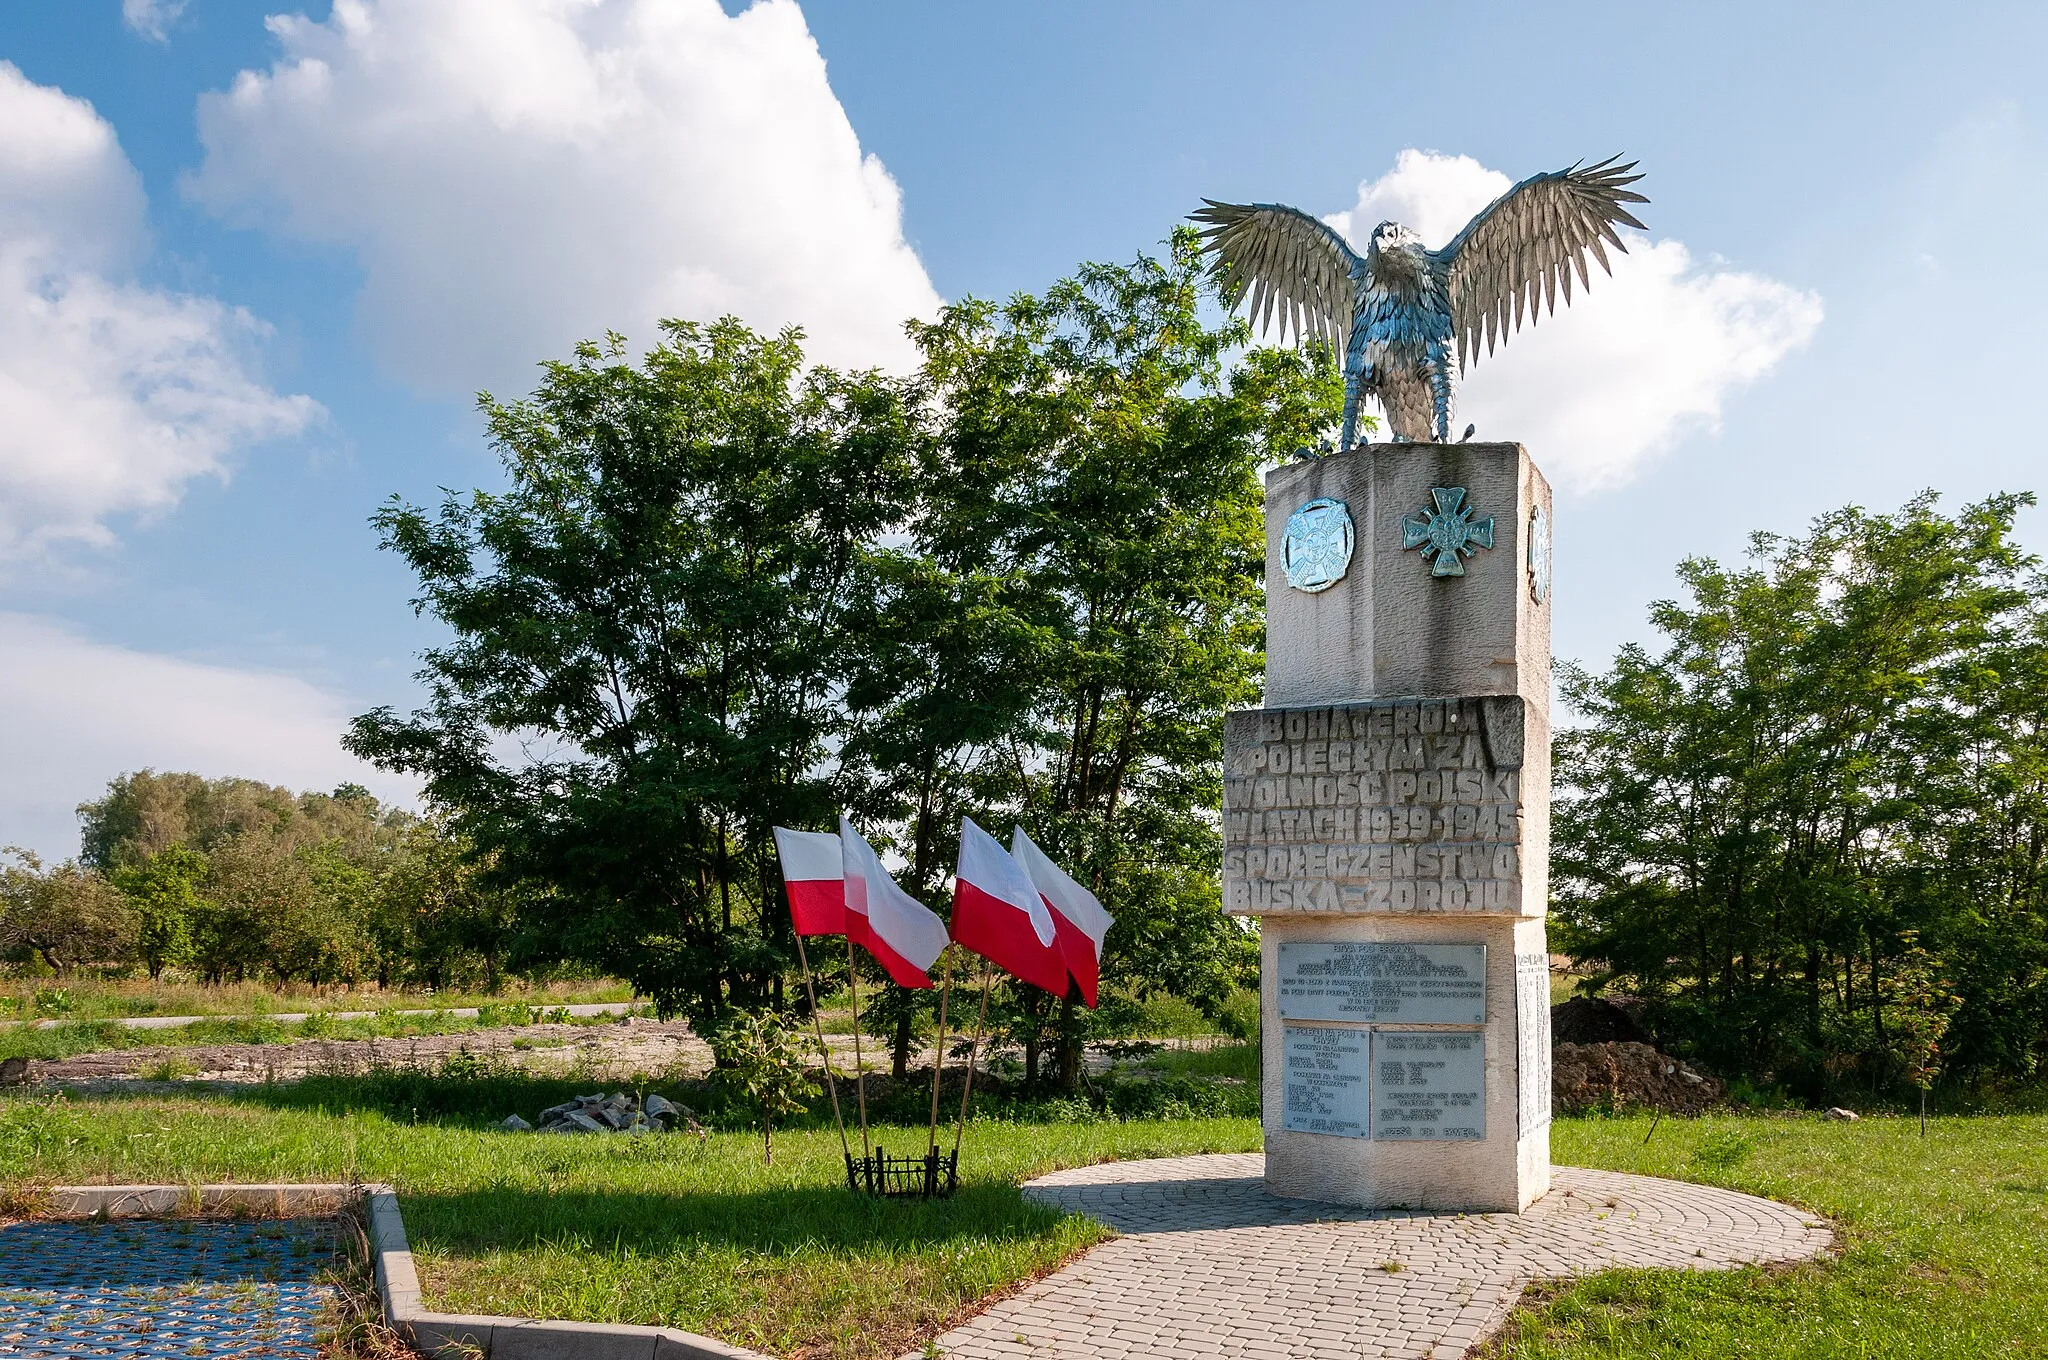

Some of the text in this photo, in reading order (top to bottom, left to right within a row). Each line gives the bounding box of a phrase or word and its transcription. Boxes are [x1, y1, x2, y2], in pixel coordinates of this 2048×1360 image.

[1262, 698, 1480, 741] BOHATEROM
[1437, 735, 1485, 769] ZA
[1391, 768, 1519, 806] POLSKI
[1225, 805, 1519, 842] W LATACH 1939-1945
